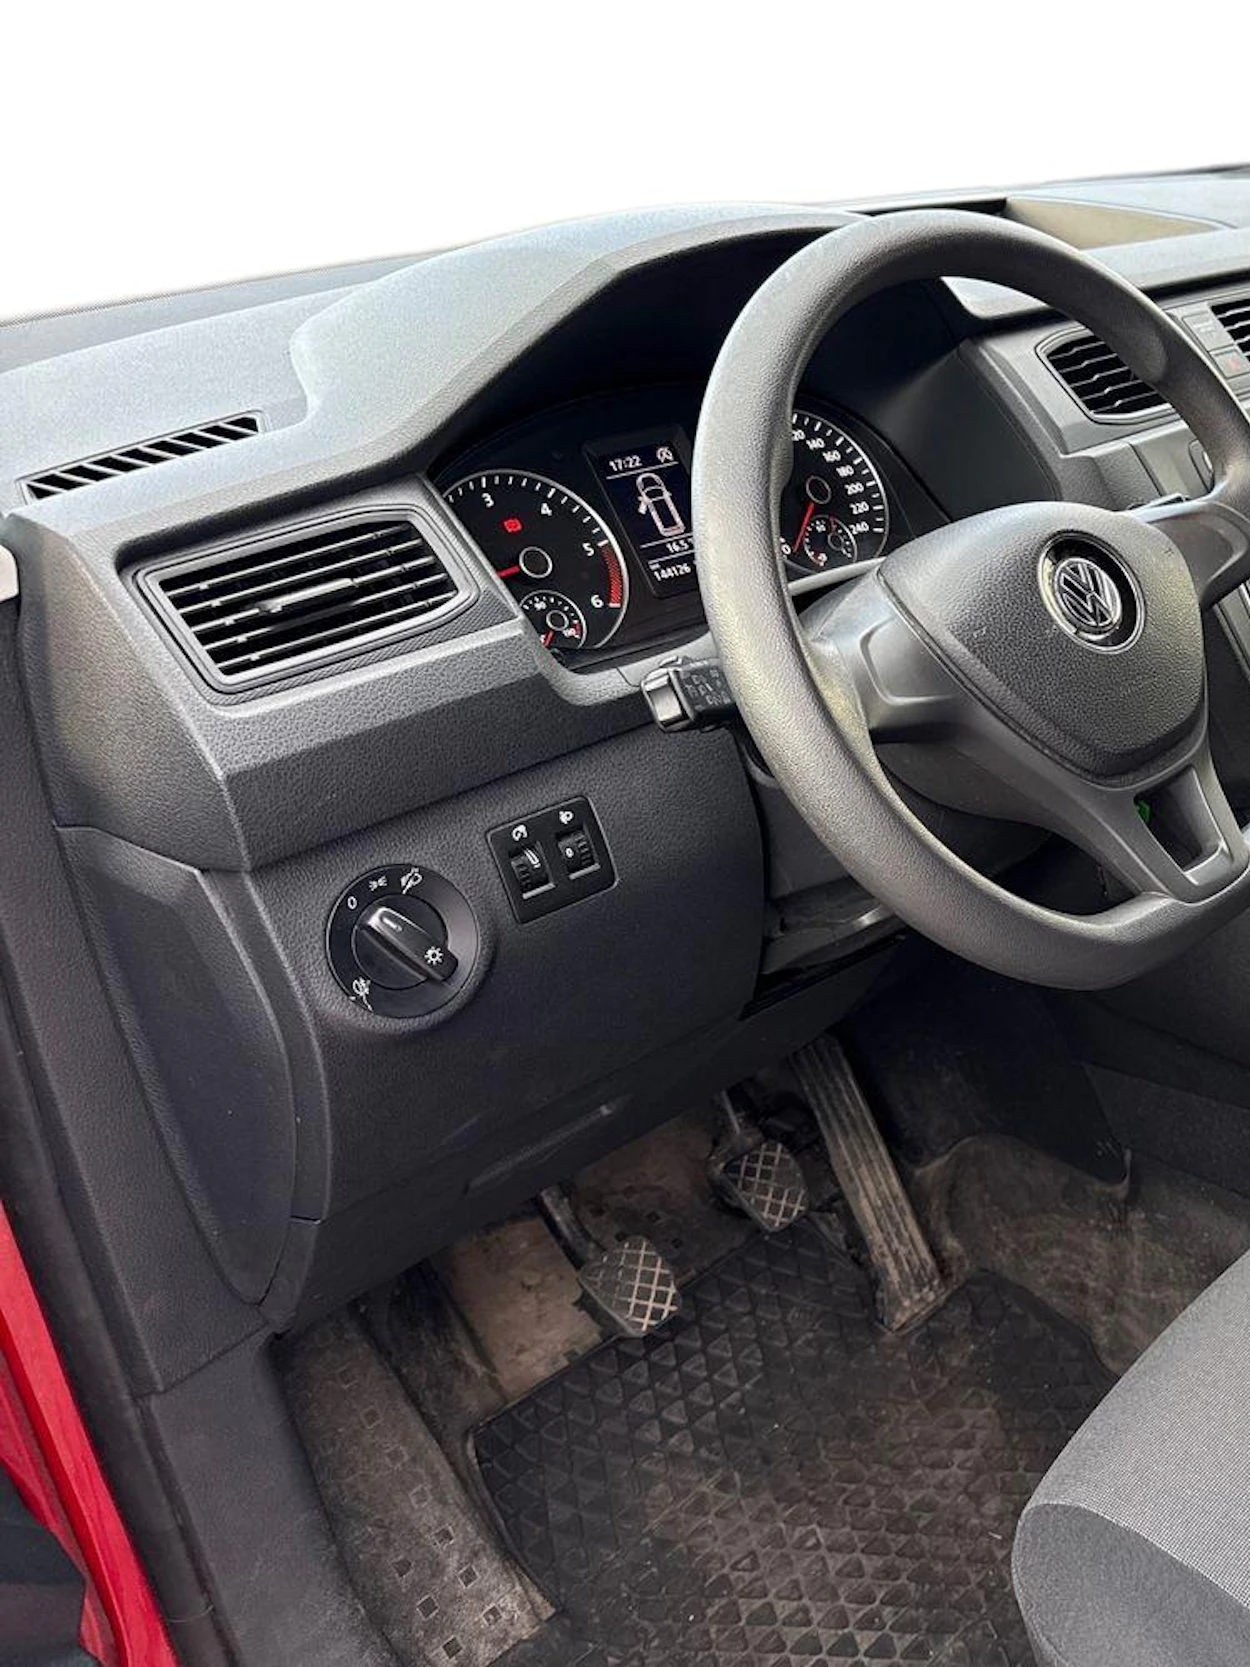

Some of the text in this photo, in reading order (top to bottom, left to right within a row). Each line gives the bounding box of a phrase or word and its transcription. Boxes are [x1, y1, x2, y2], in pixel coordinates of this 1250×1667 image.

[791, 430, 805, 441] 20
[806, 438, 825, 450] 140
[822, 450, 841, 462] 160
[609, 455, 642, 471] 17:22
[836, 465, 854, 477] 180
[844, 483, 864, 495] 200
[481, 493, 494, 508] 3
[541, 503, 552, 516] 4
[850, 501, 869, 514] 220
[850, 521, 869, 534] 240
[583, 543, 594, 556] 5
[591, 595, 603, 608] 6
[347, 896, 357, 909] 0
